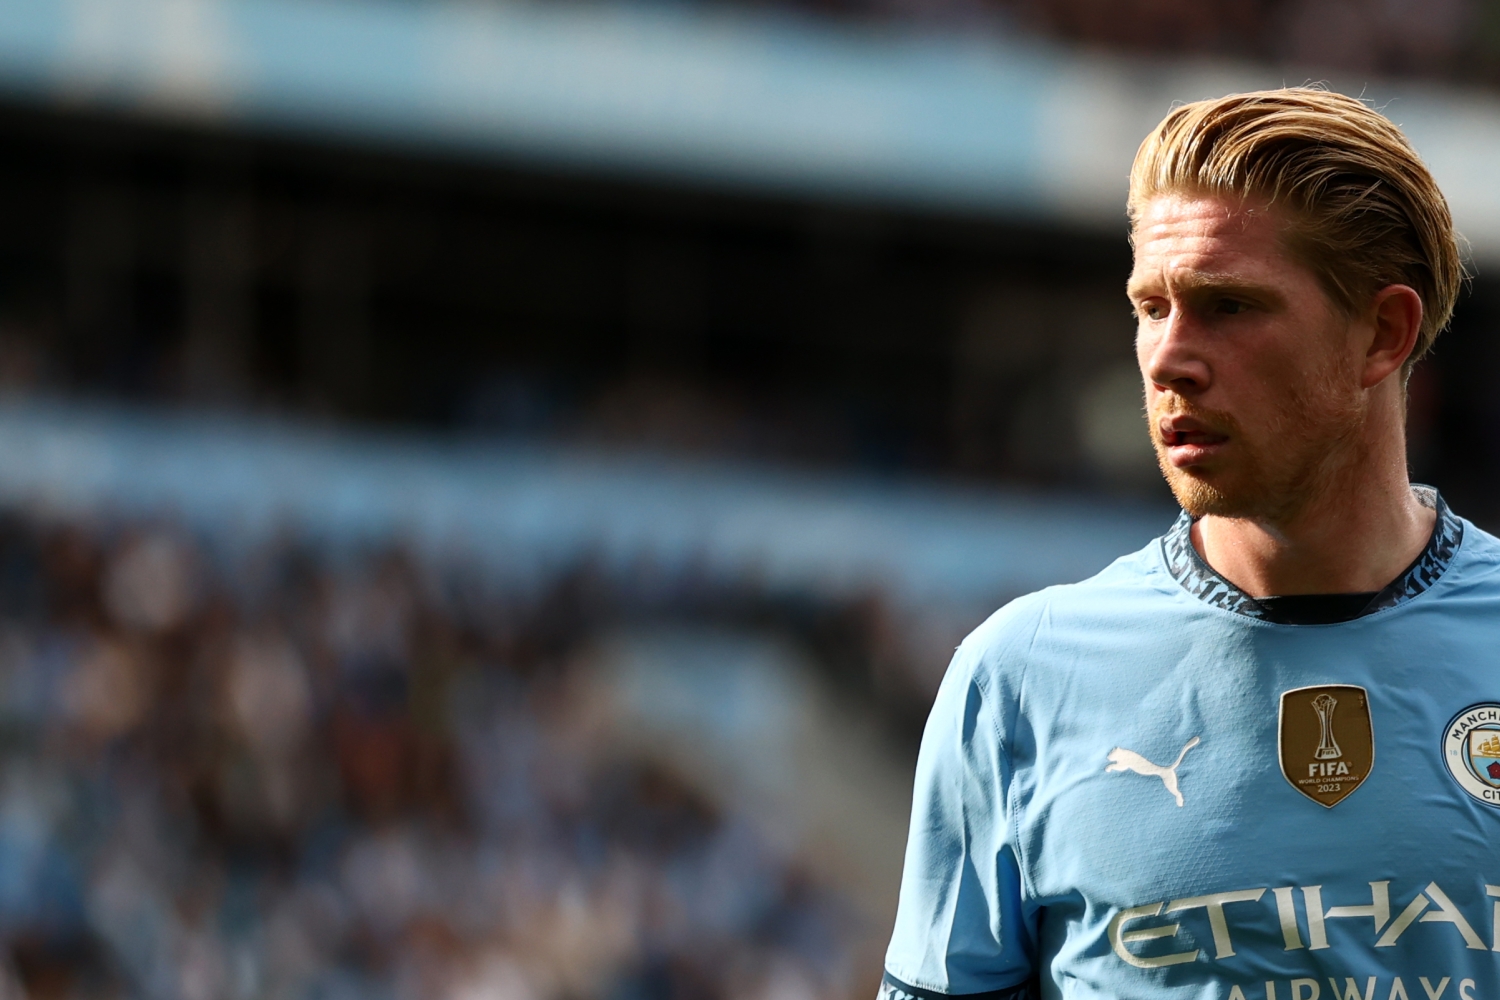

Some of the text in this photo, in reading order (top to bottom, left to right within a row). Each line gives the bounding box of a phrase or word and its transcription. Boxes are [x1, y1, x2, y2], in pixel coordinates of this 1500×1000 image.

[1308, 761, 1350, 777] FIFA
[1322, 776, 1359, 784] CHAMPIONS
[1317, 783, 1341, 793] 2023
